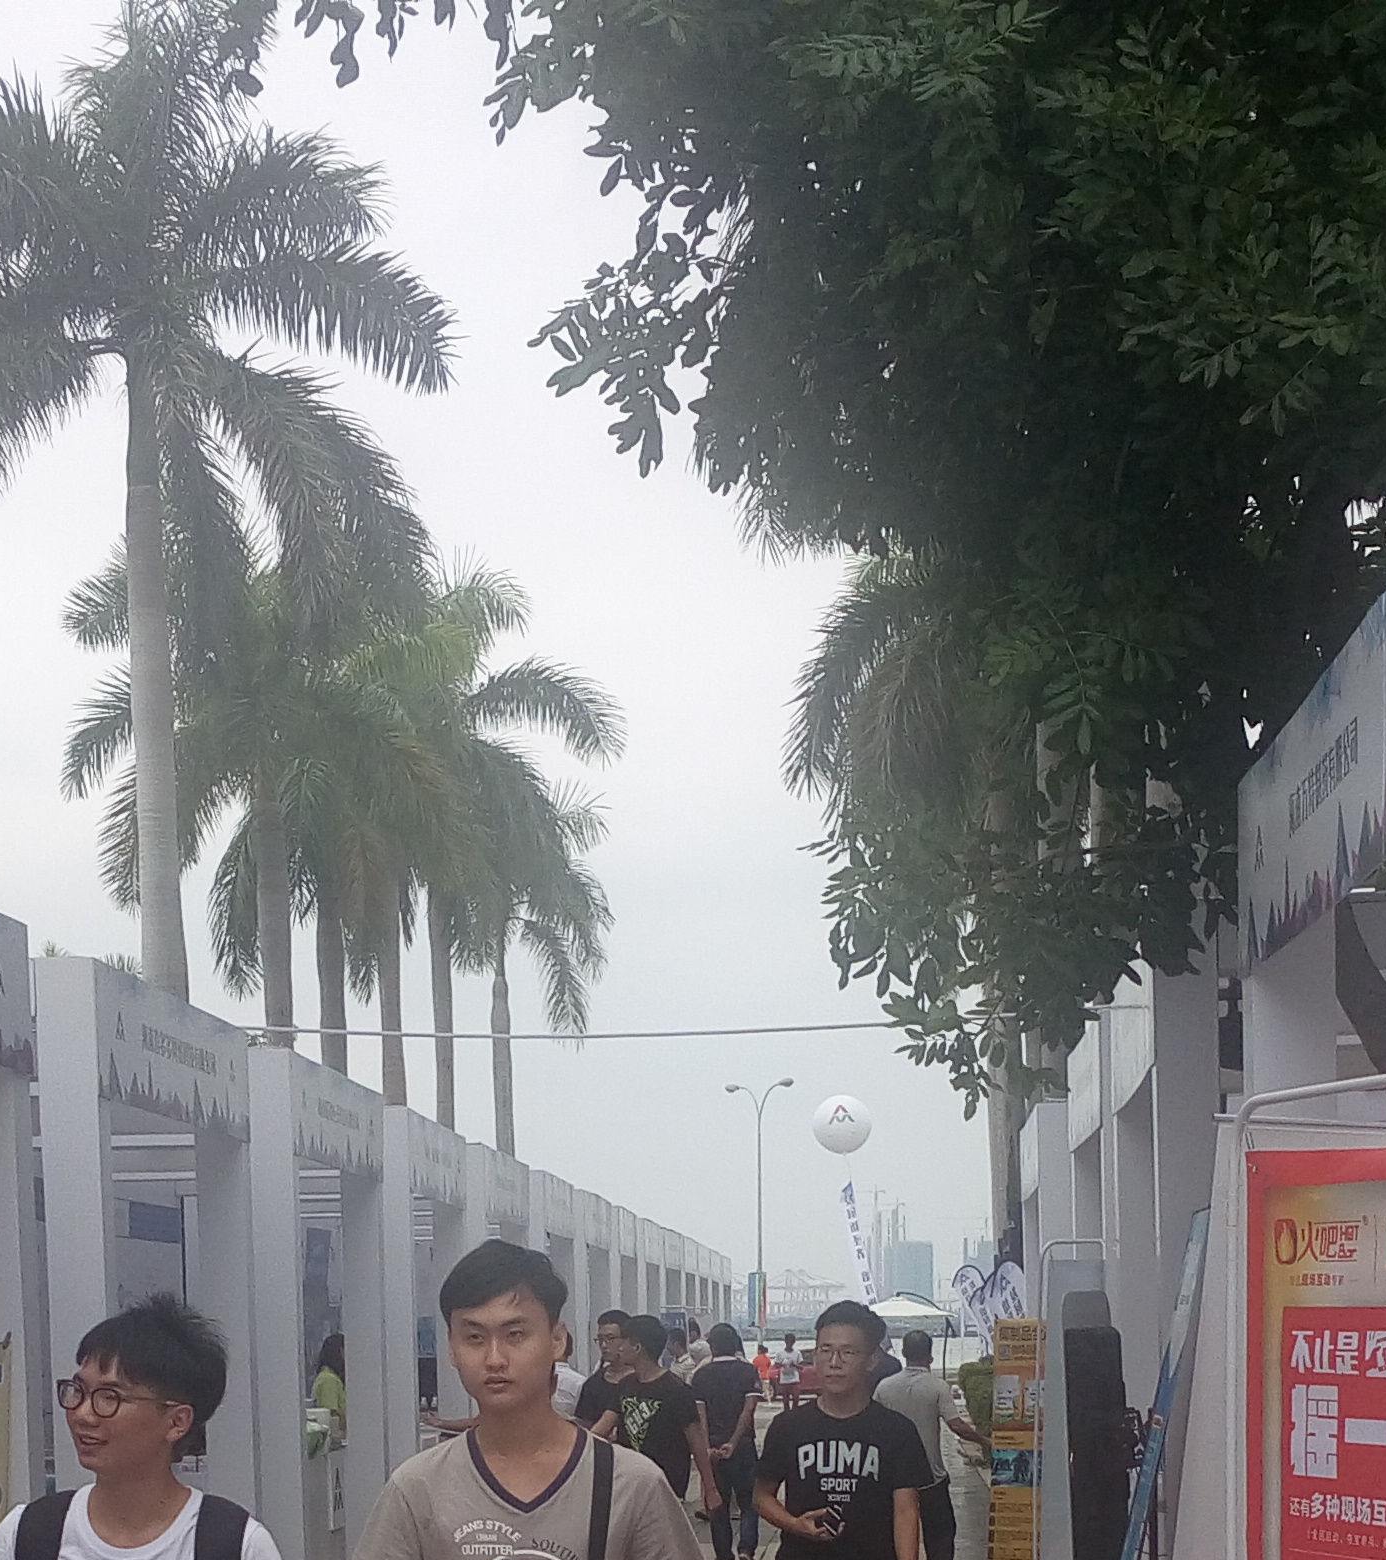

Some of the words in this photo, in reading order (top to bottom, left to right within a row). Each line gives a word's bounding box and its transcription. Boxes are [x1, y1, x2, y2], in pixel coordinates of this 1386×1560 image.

[1290, 1329, 1360, 1375] 不止是
[797, 1440, 880, 1482] PUMA
[820, 1478, 858, 1492] SPORT
[453, 1520, 484, 1542] JEANS
[485, 1520, 522, 1542] STYLE
